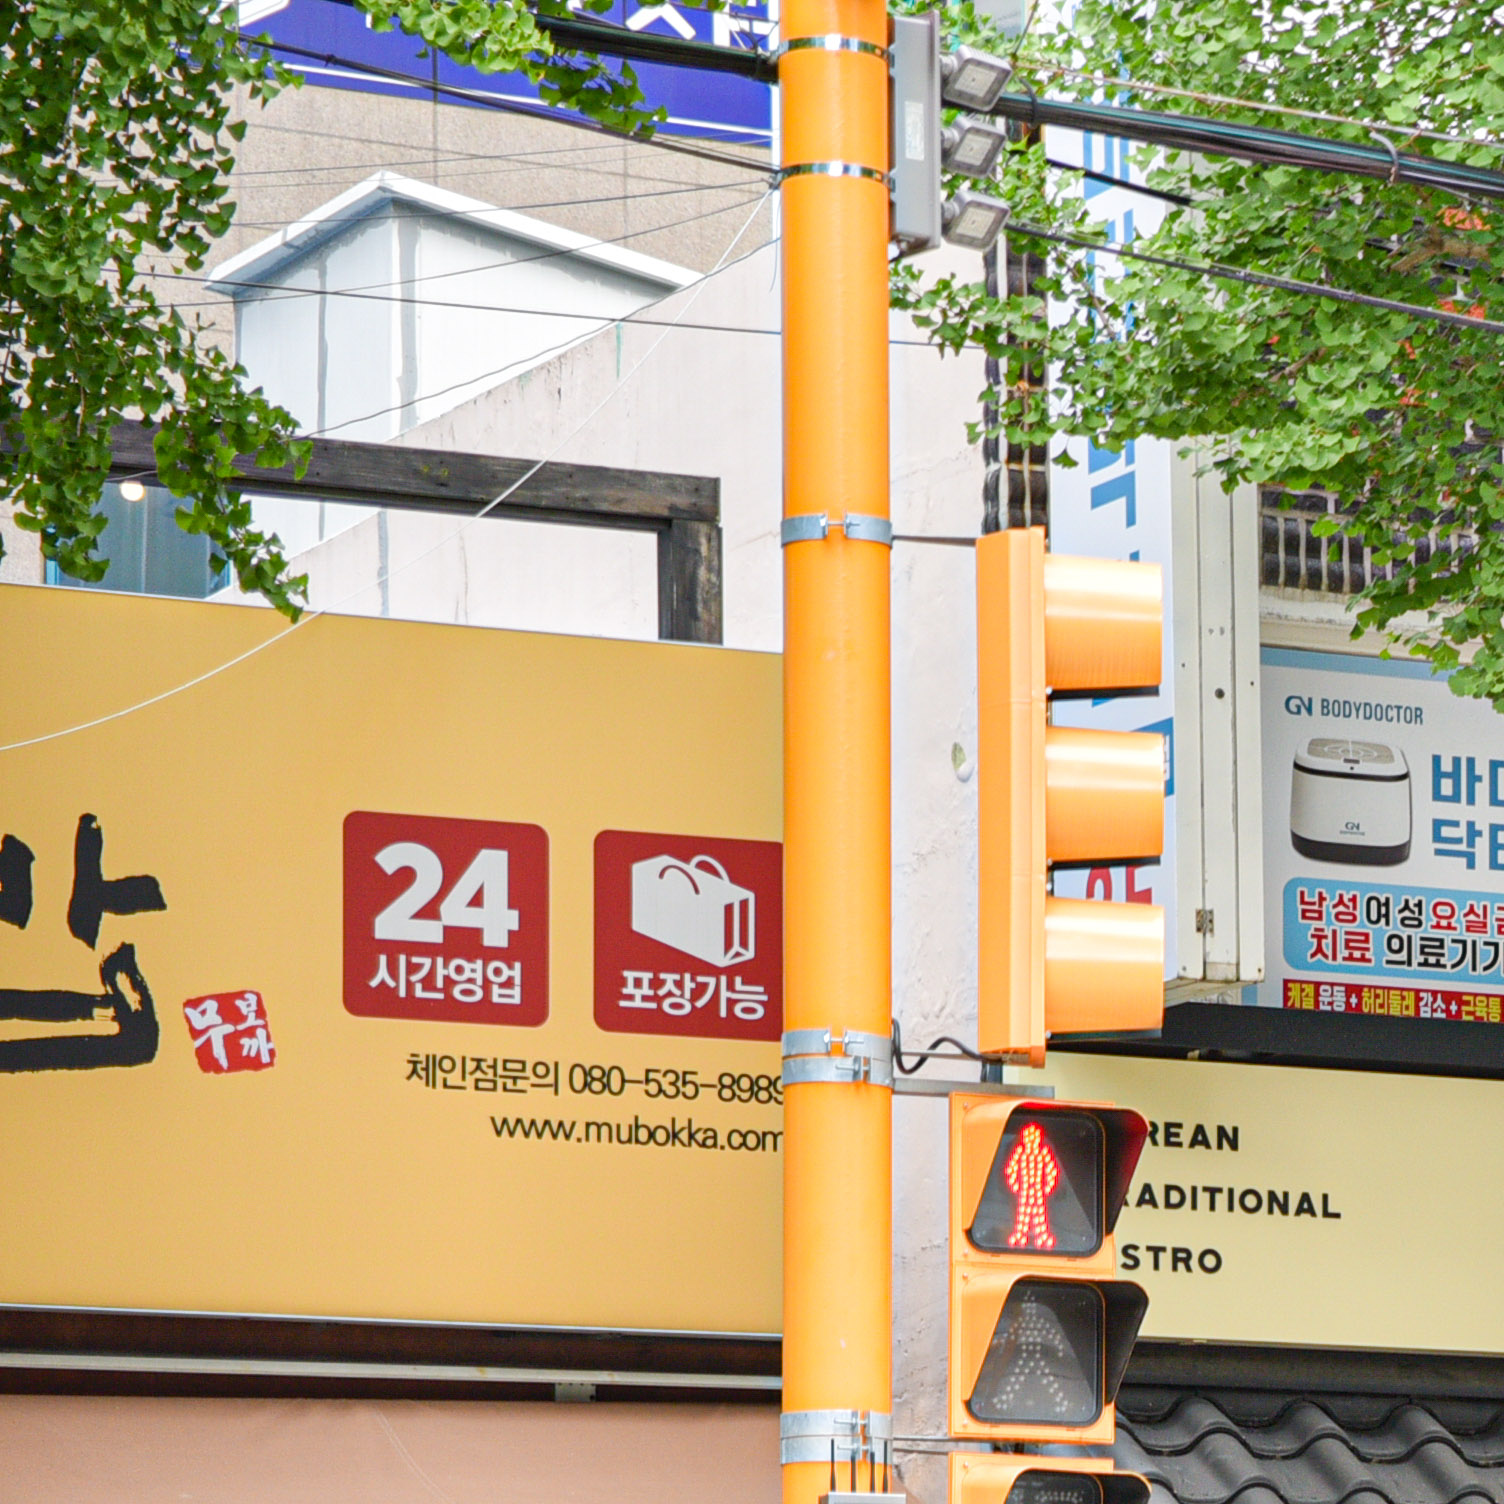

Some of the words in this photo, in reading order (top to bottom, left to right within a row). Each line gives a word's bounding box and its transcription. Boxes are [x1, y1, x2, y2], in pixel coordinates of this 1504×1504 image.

[1320, 698, 1424, 725] BODYDOCTOR
[373, 841, 520, 948] 24
[1309, 927, 1372, 964] 치료
[369, 953, 523, 1005] 시간영업
[618, 970, 769, 1020] 포장가능
[1318, 984, 1346, 1011] 운동
[1362, 987, 1416, 1017] 허리둘레
[1419, 992, 1447, 1019] 감소
[1461, 995, 1501, 1024] 근육통
[405, 1053, 561, 1097] 체인점문의
[490, 1115, 784, 1153] www.mubokka.com
[1122, 1182, 1342, 1219] ADITIONAL
